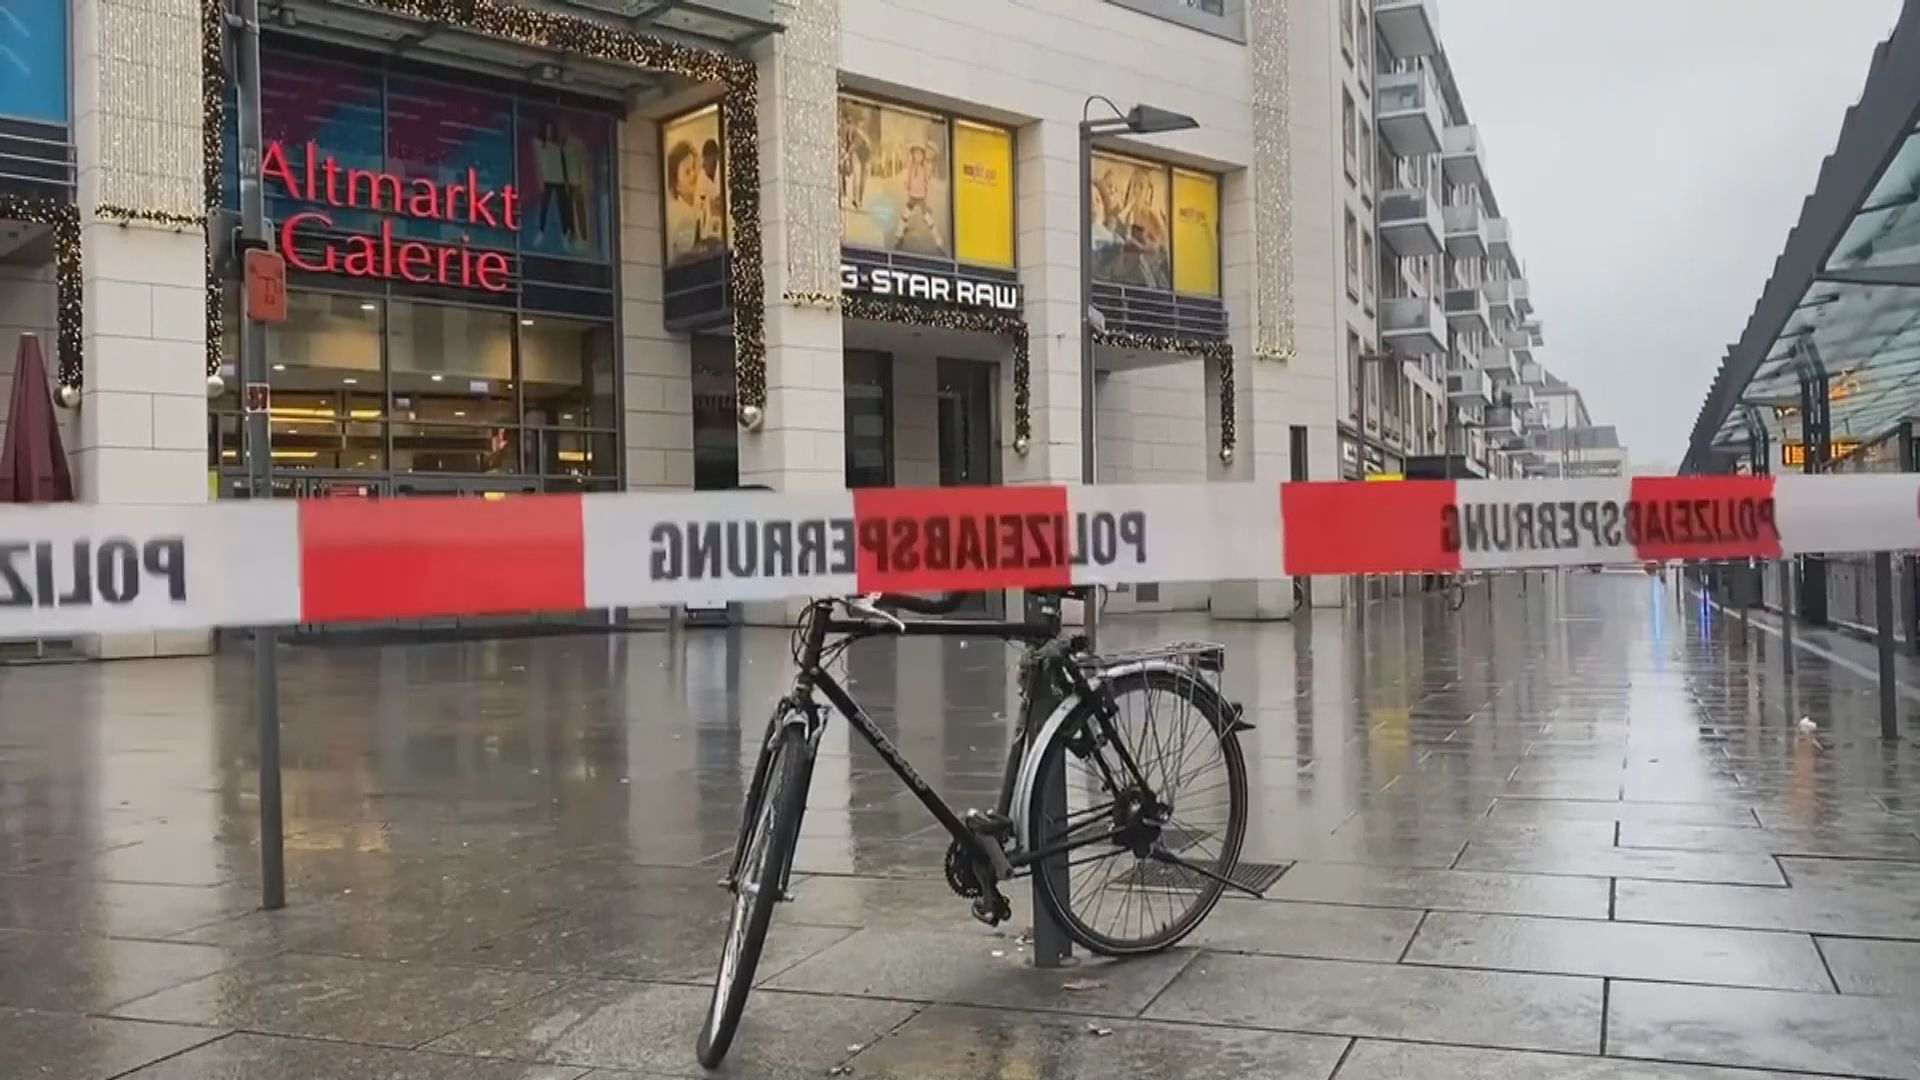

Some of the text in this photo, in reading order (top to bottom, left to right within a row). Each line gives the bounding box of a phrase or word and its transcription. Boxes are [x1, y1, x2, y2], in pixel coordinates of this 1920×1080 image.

[262, 140, 521, 231] Altmarkt
[281, 211, 509, 292] Galerie
[956, 280, 1017, 310] RAW
